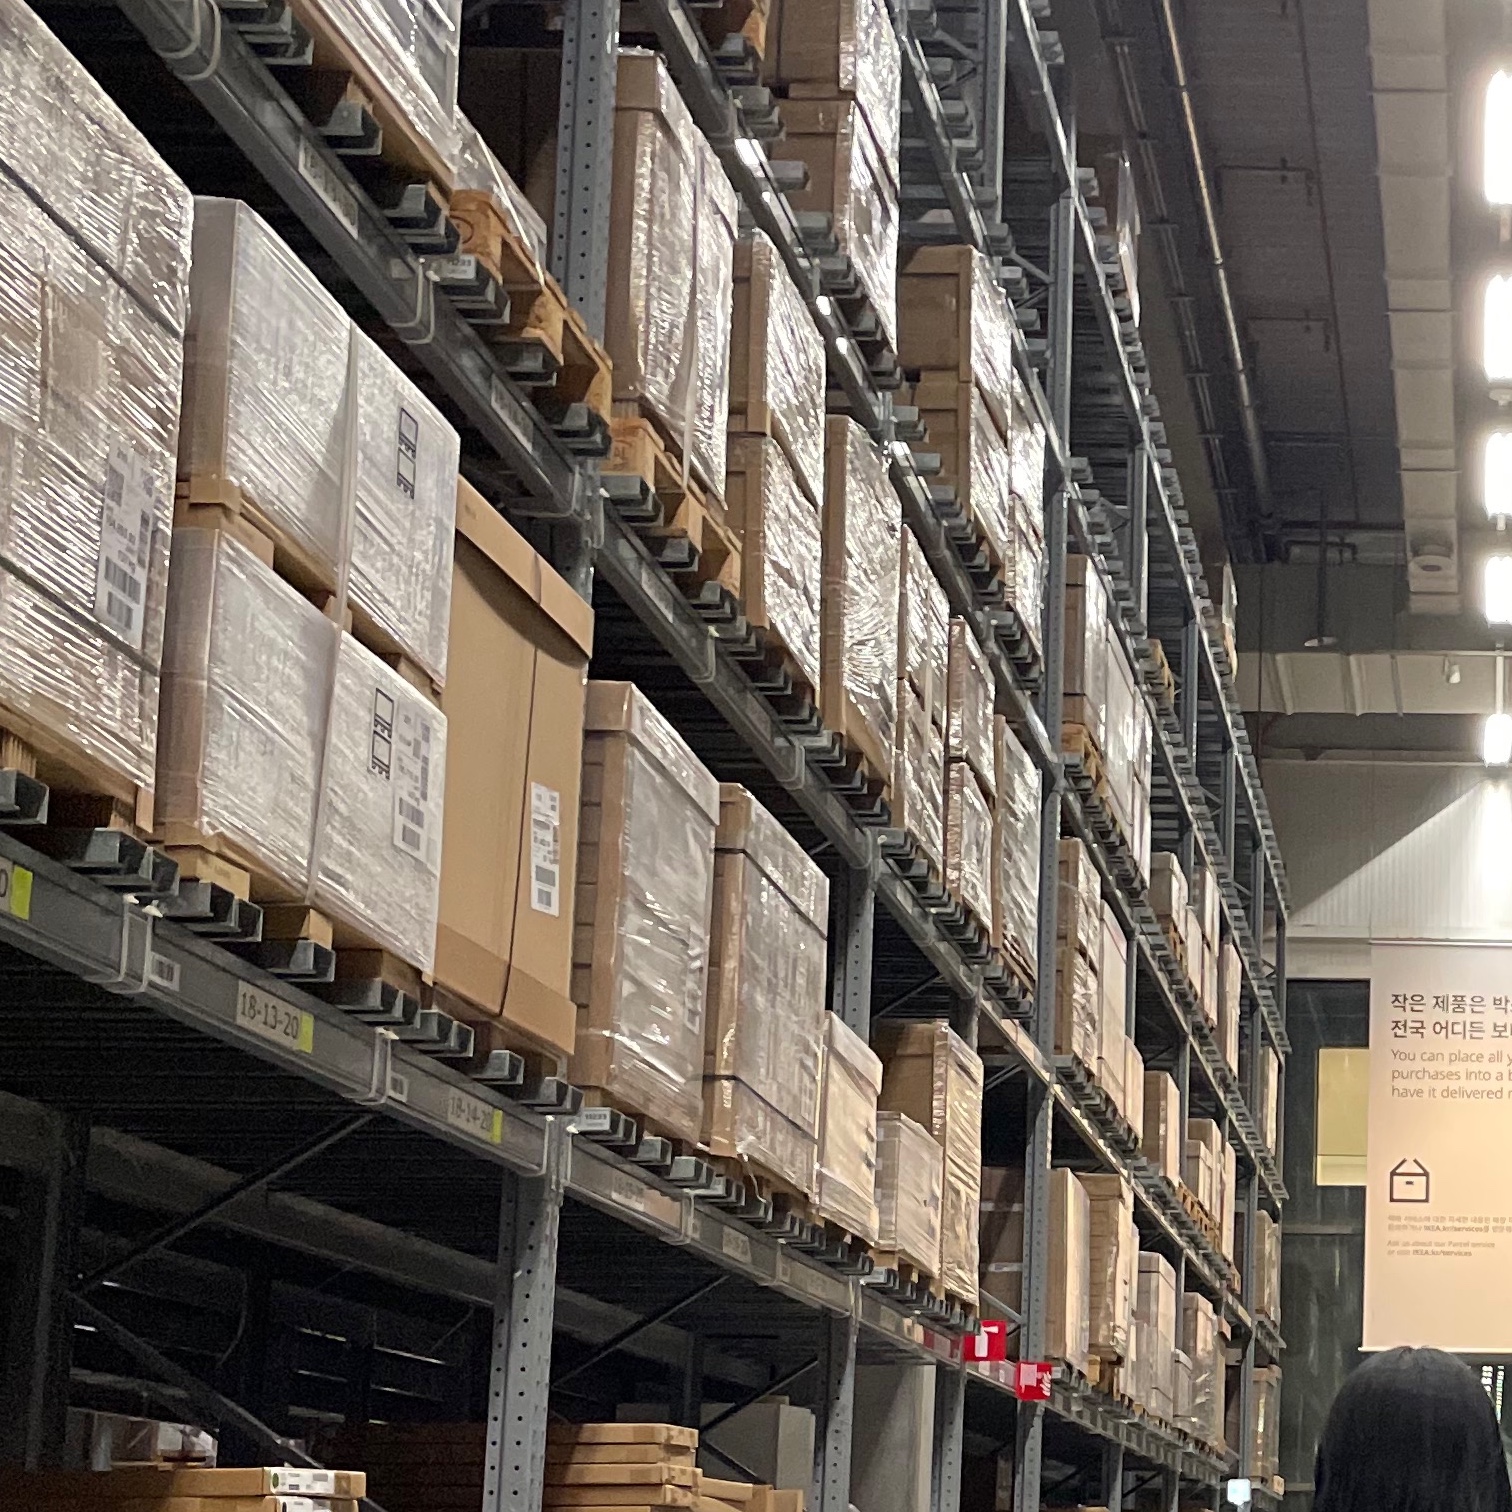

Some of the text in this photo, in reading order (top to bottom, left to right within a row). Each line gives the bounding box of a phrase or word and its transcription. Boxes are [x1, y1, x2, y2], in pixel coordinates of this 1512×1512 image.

[1391, 993, 1427, 1013] 작은
[1432, 994, 1486, 1014] 제품은
[241, 992, 299, 1039] 18-13-20
[1391, 1019, 1426, 1039] 전국
[1432, 1020, 1485, 1040] 어디든
[1391, 1049, 1416, 1062] You
[1420, 1051, 1444, 1062] can
[1448, 1050, 1484, 1065] place
[1488, 1050, 1503, 1063] all
[1391, 1068, 1461, 1081] purchases
[1465, 1069, 1491, 1082] into
[1495, 1071, 1503, 1082] a
[1391, 1085, 1424, 1098] have
[1428, 1086, 1437, 1098] it
[1441, 1086, 1503, 1099] delivered
